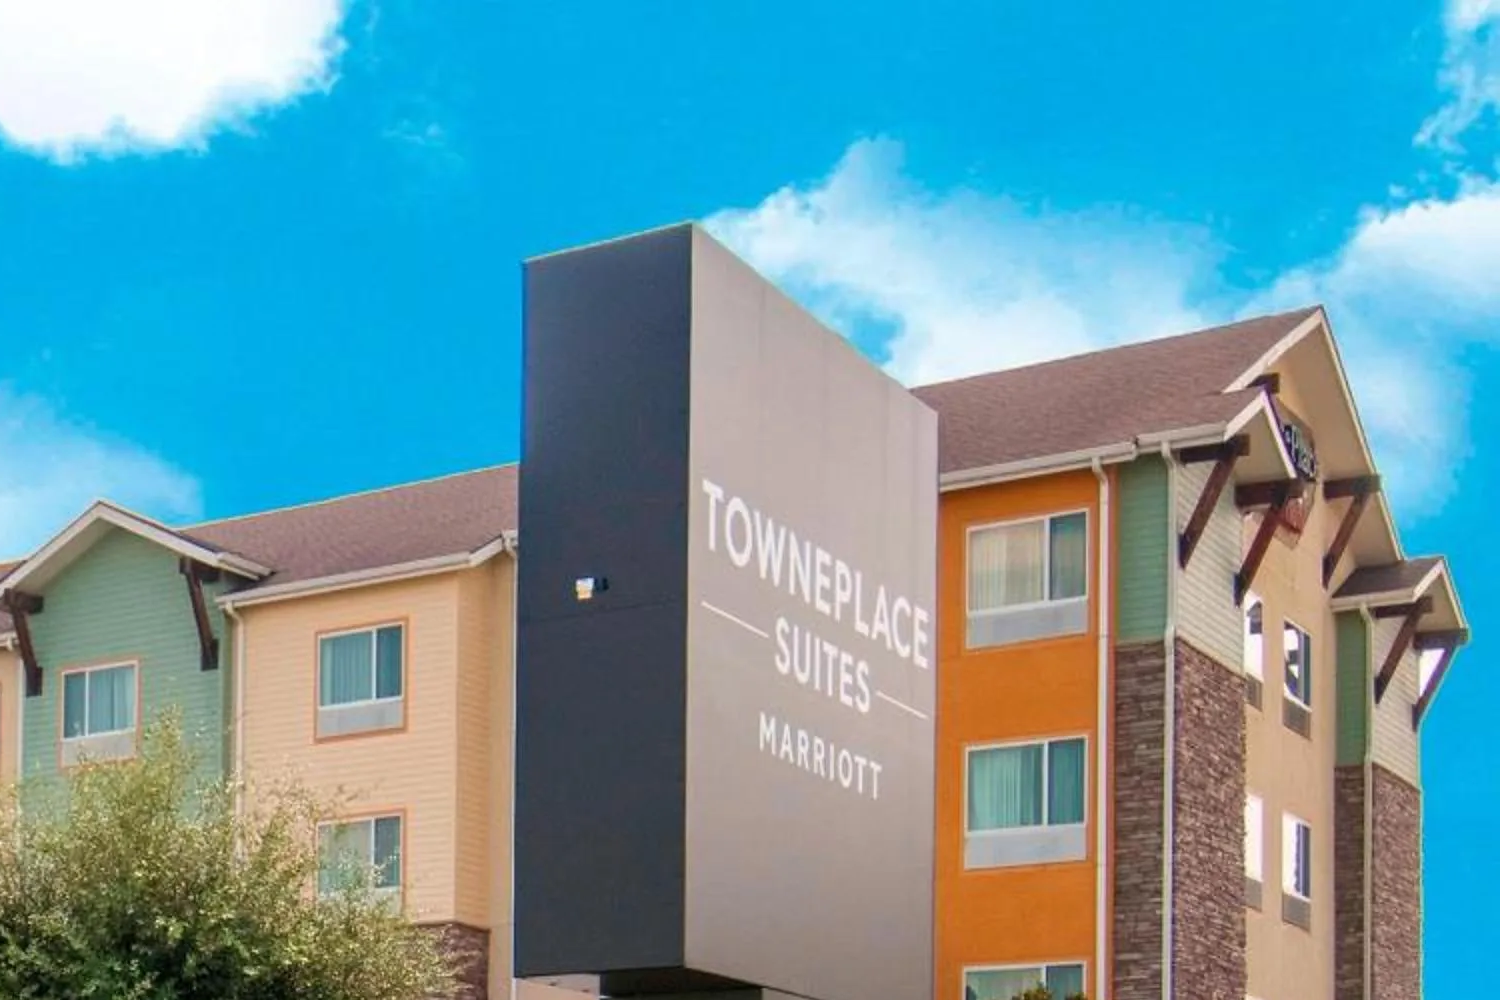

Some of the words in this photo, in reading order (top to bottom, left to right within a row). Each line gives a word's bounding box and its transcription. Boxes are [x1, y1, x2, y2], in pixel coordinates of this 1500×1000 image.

[702, 479, 930, 669] TOWNEPLACE
[774, 616, 871, 713] SUITES
[758, 712, 882, 800] MARRIOTT
